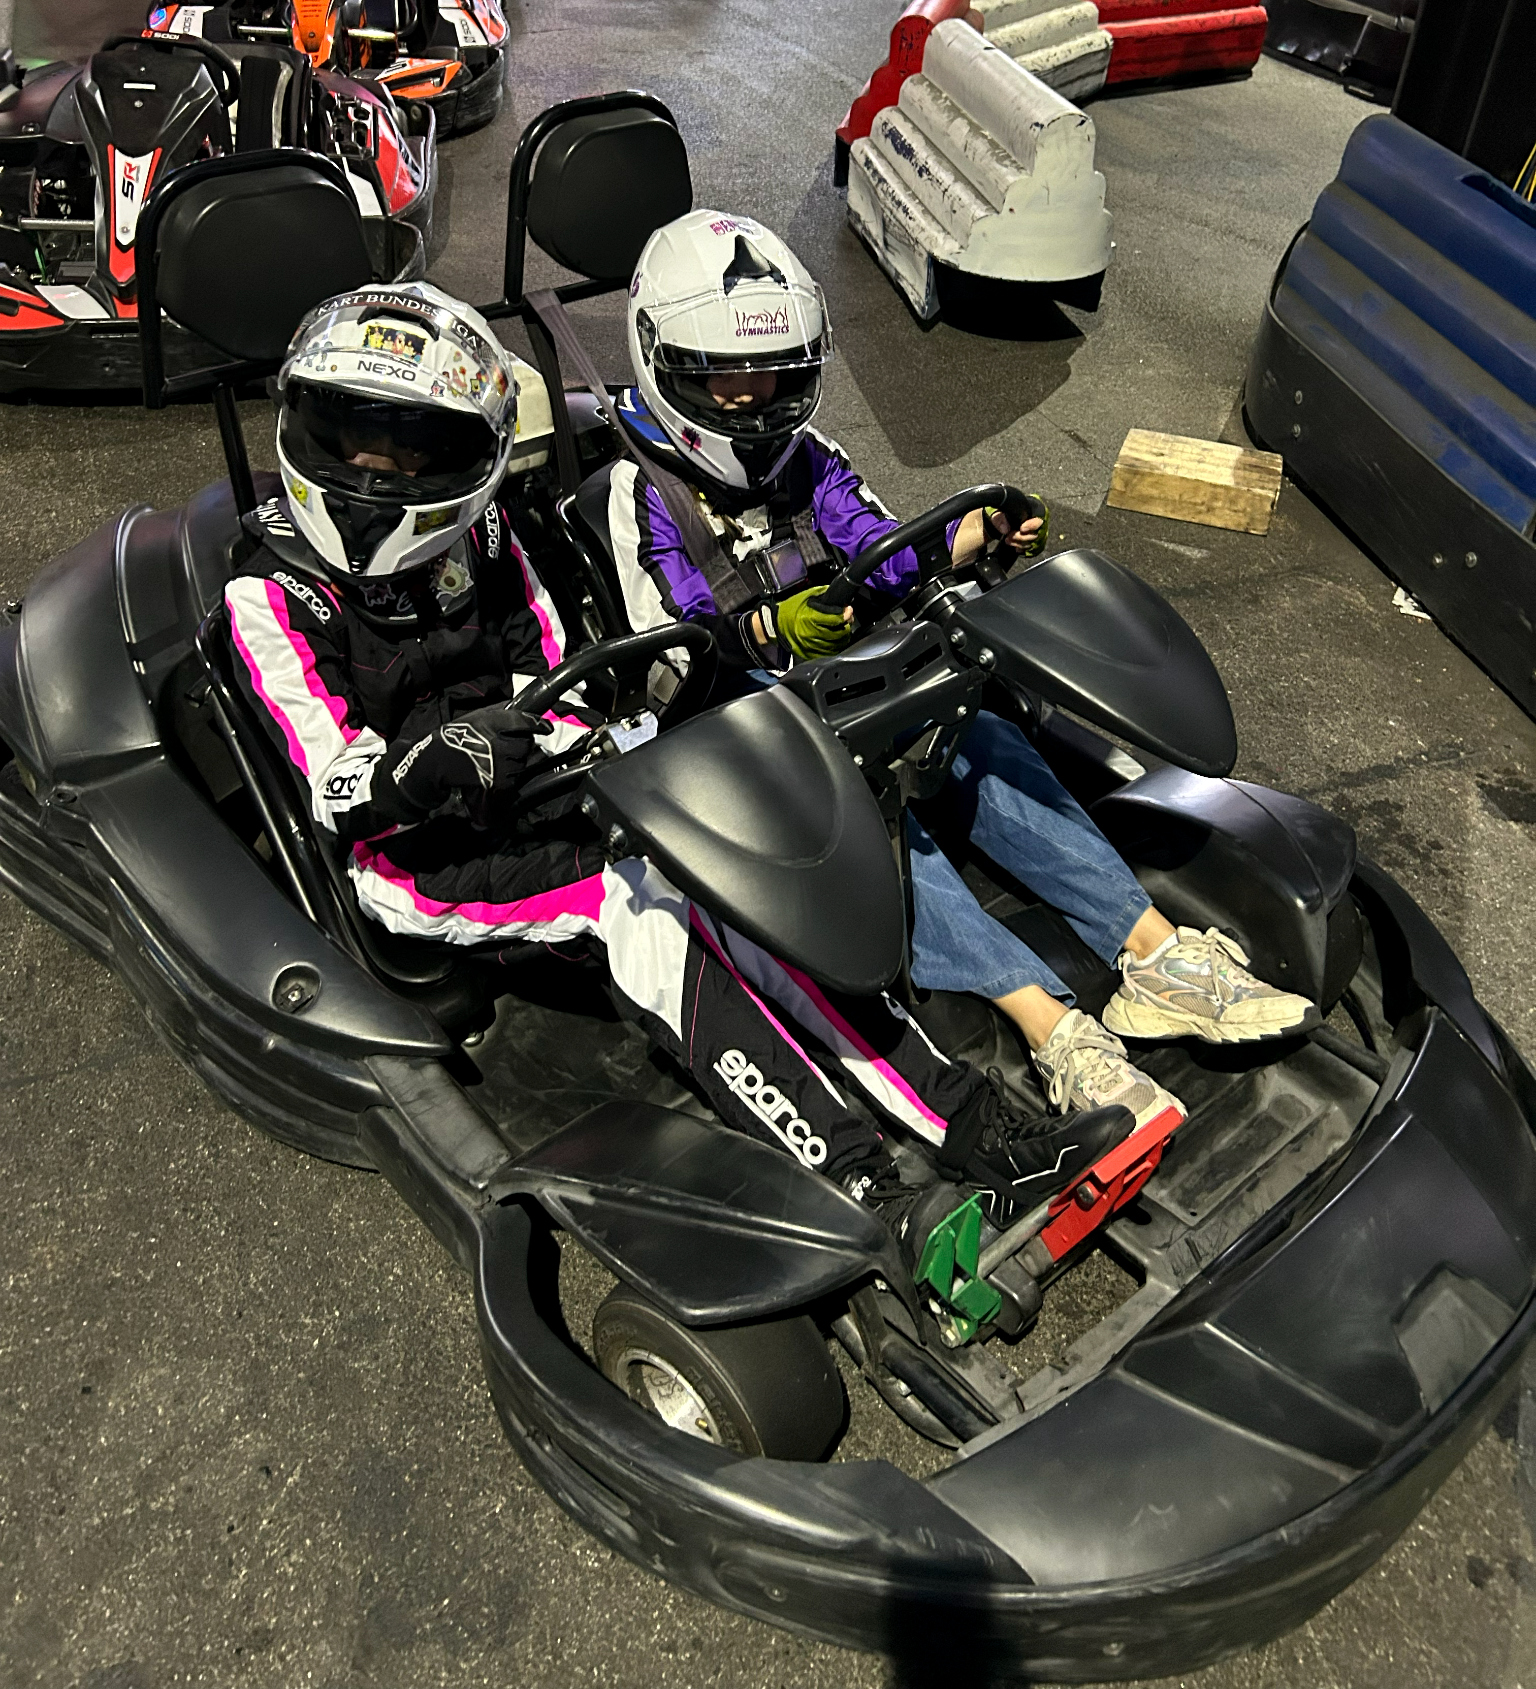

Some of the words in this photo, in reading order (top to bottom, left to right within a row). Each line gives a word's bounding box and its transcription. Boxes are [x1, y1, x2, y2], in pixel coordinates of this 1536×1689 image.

[317, 294, 363, 316] KART
[366, 294, 478, 348] BUNDESIGA
[735, 325, 790, 337] GYMNASTICS
[357, 360, 416, 382] NEXO
[485, 501, 500, 560] sparc
[270, 571, 331, 625] sparco
[392, 733, 433, 785] ASTARS
[713, 1049, 828, 1170] sparco
